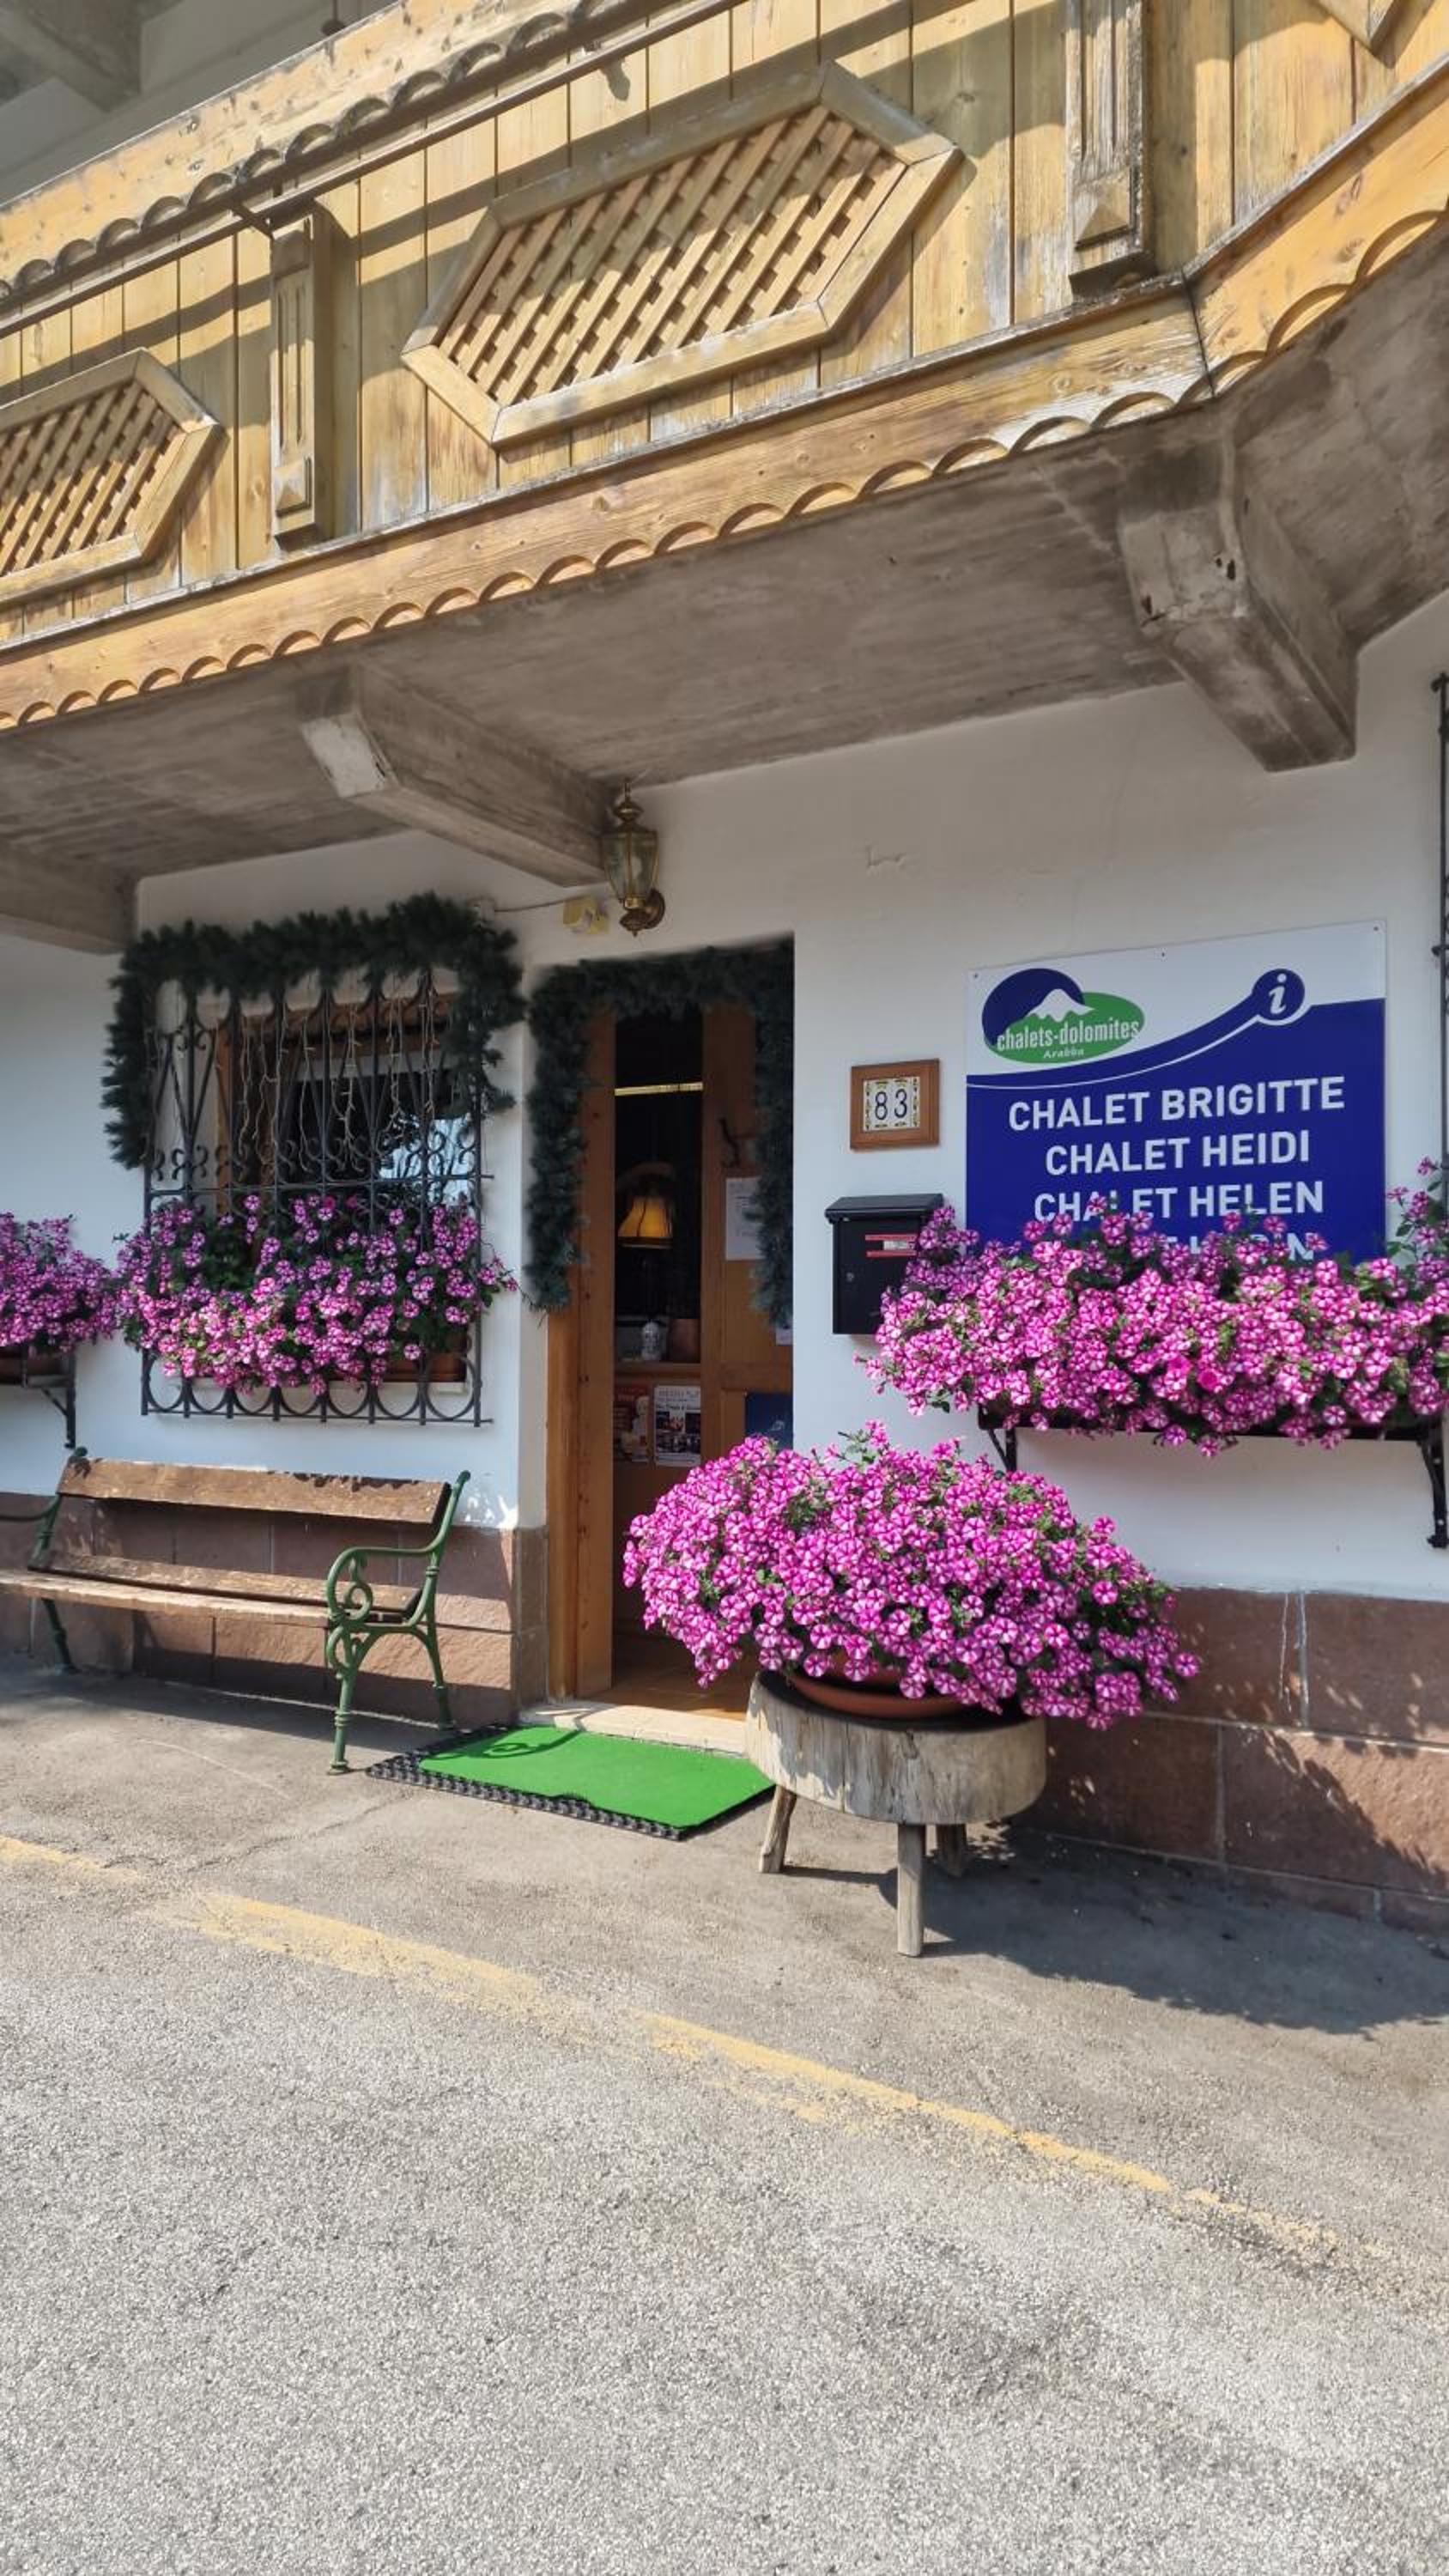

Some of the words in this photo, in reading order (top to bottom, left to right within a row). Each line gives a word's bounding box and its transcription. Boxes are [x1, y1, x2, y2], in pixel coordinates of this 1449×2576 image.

[1269, 973, 1287, 1014] i
[997, 1017, 1140, 1052] chalets-dolomites
[1043, 1048, 1084, 1059] Arabba
[875, 1088, 907, 1120] 83
[1009, 1091, 1150, 1131] CHALET
[1161, 1076, 1345, 1121] BRIGITTE
[1046, 1137, 1191, 1176] CHALET
[1203, 1130, 1309, 1167] HEIDI
[1190, 1182, 1323, 1217] HELEN
